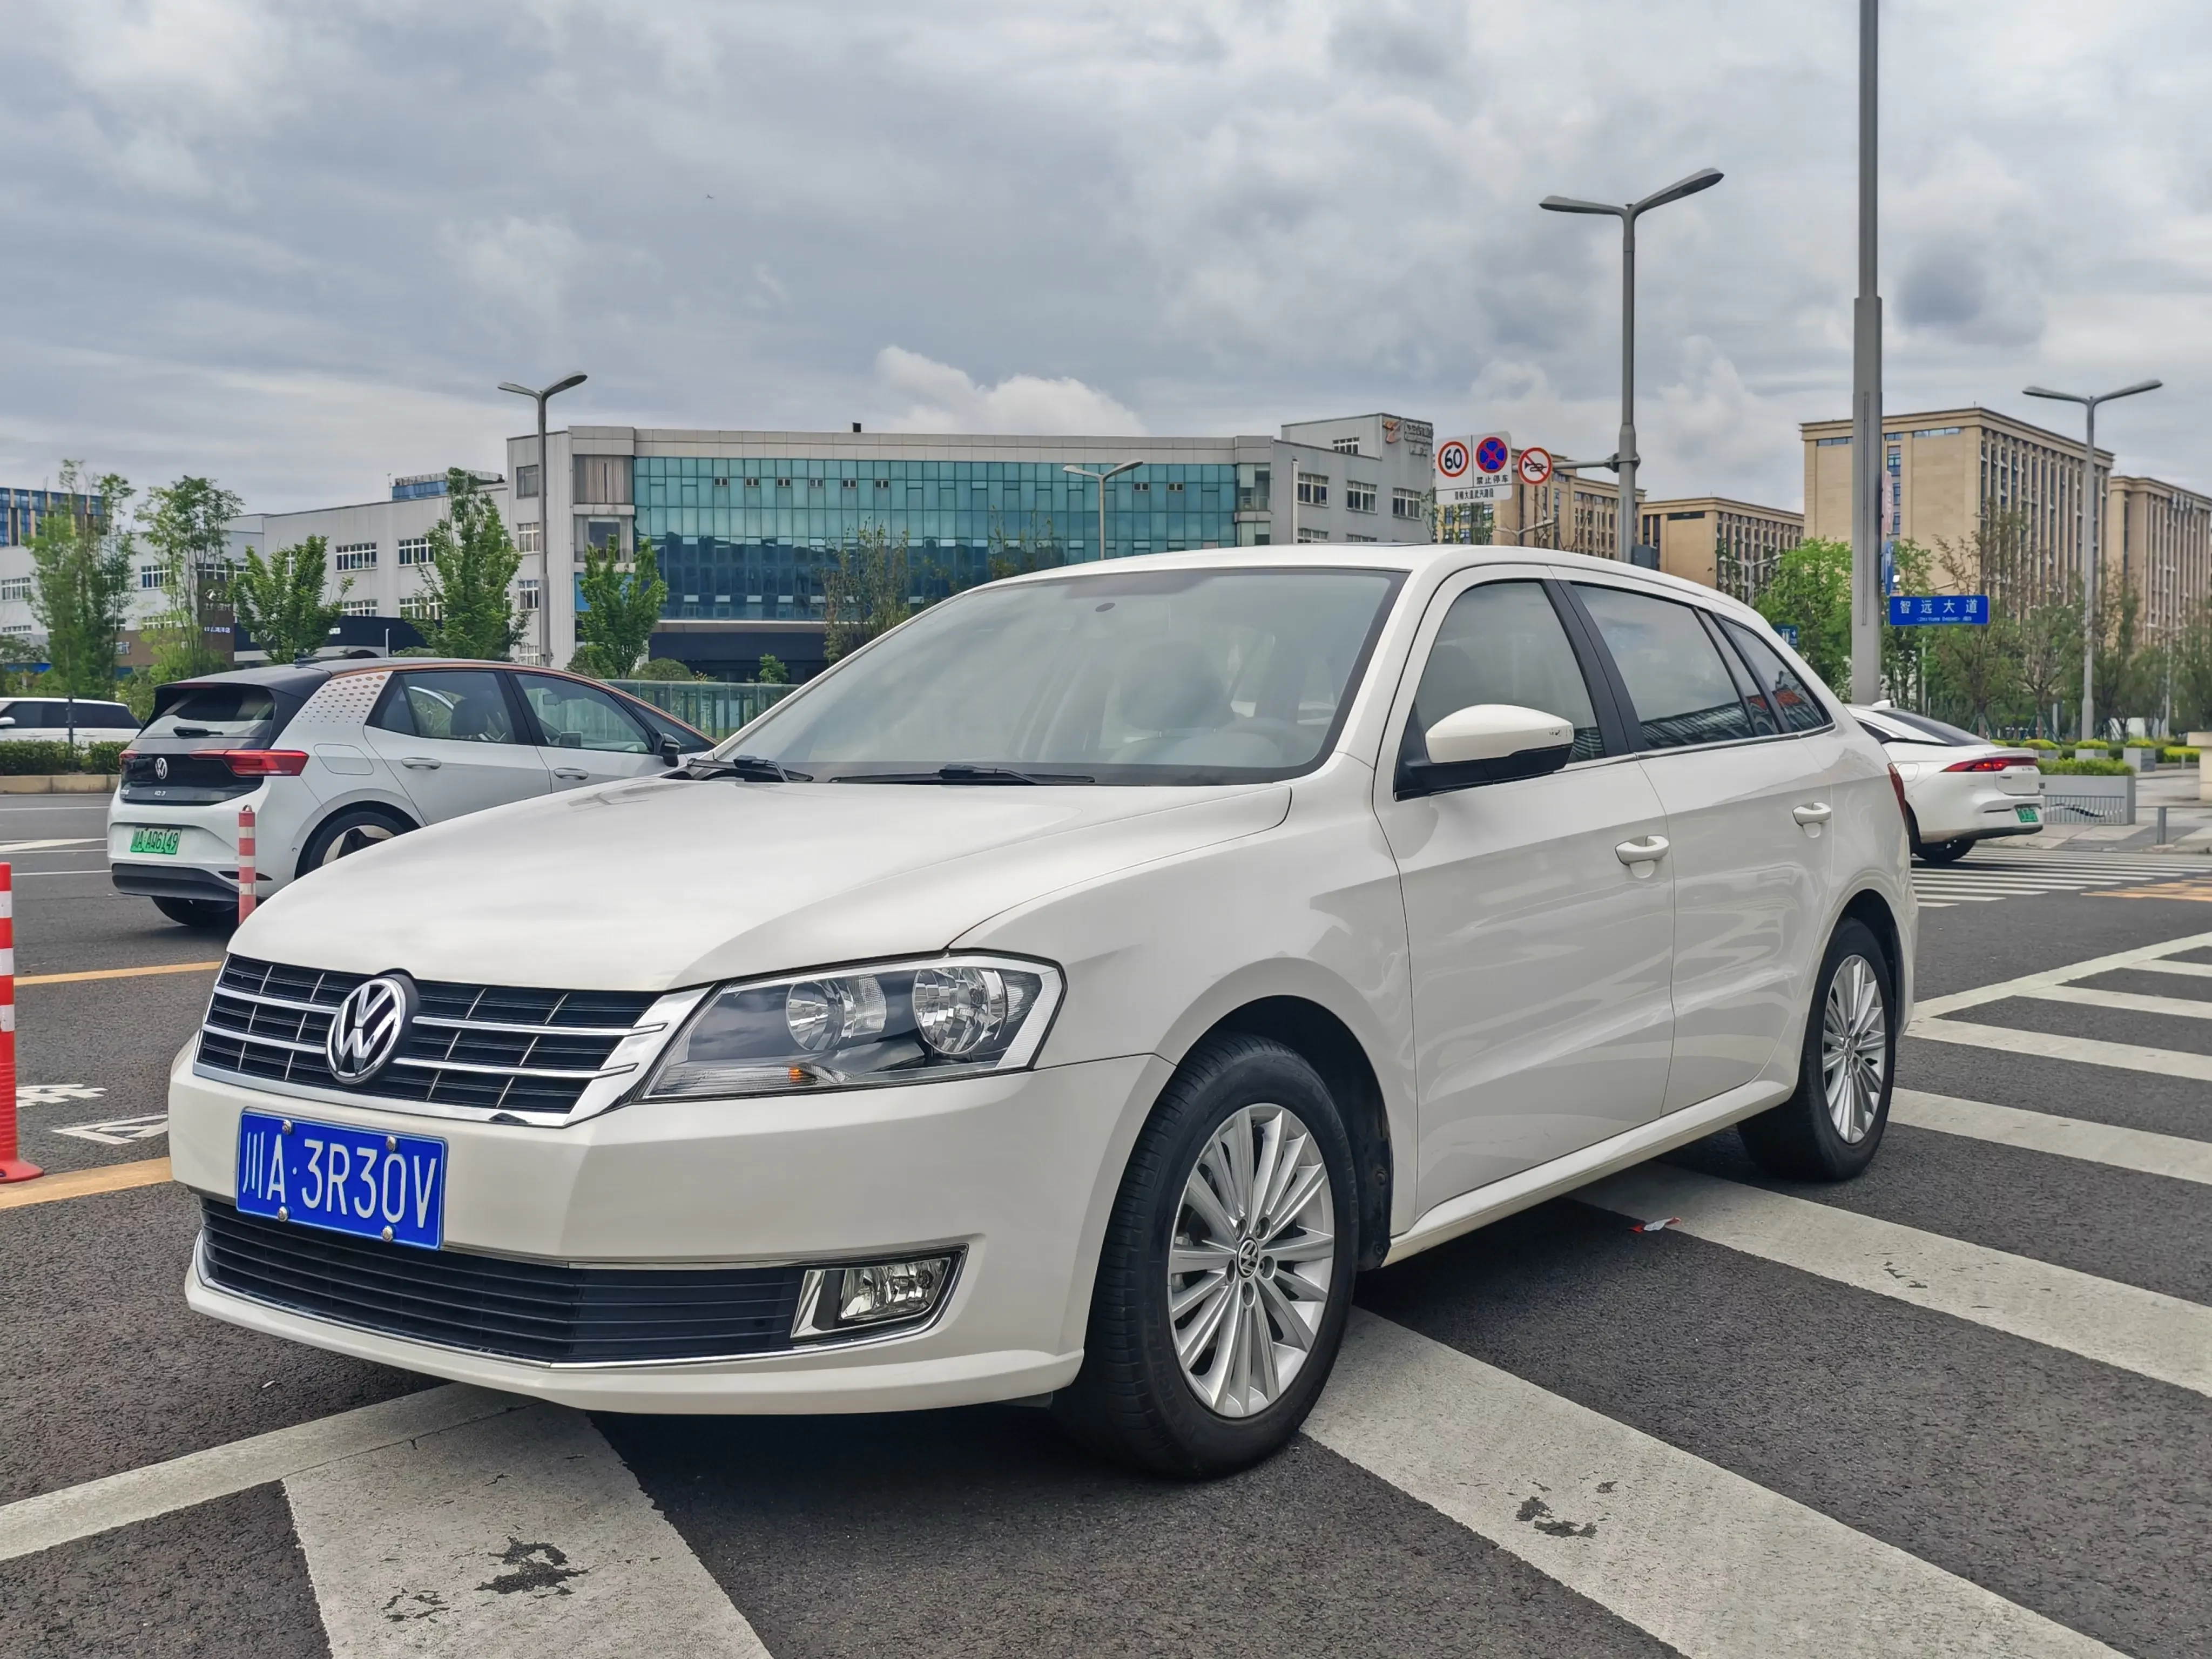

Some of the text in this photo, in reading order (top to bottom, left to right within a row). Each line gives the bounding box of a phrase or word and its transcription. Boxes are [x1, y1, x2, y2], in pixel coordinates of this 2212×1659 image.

[1445, 448, 1462, 470] 60
[1476, 474, 1508, 484] 禁止停车
[1900, 598, 1978, 614] 智远大道
